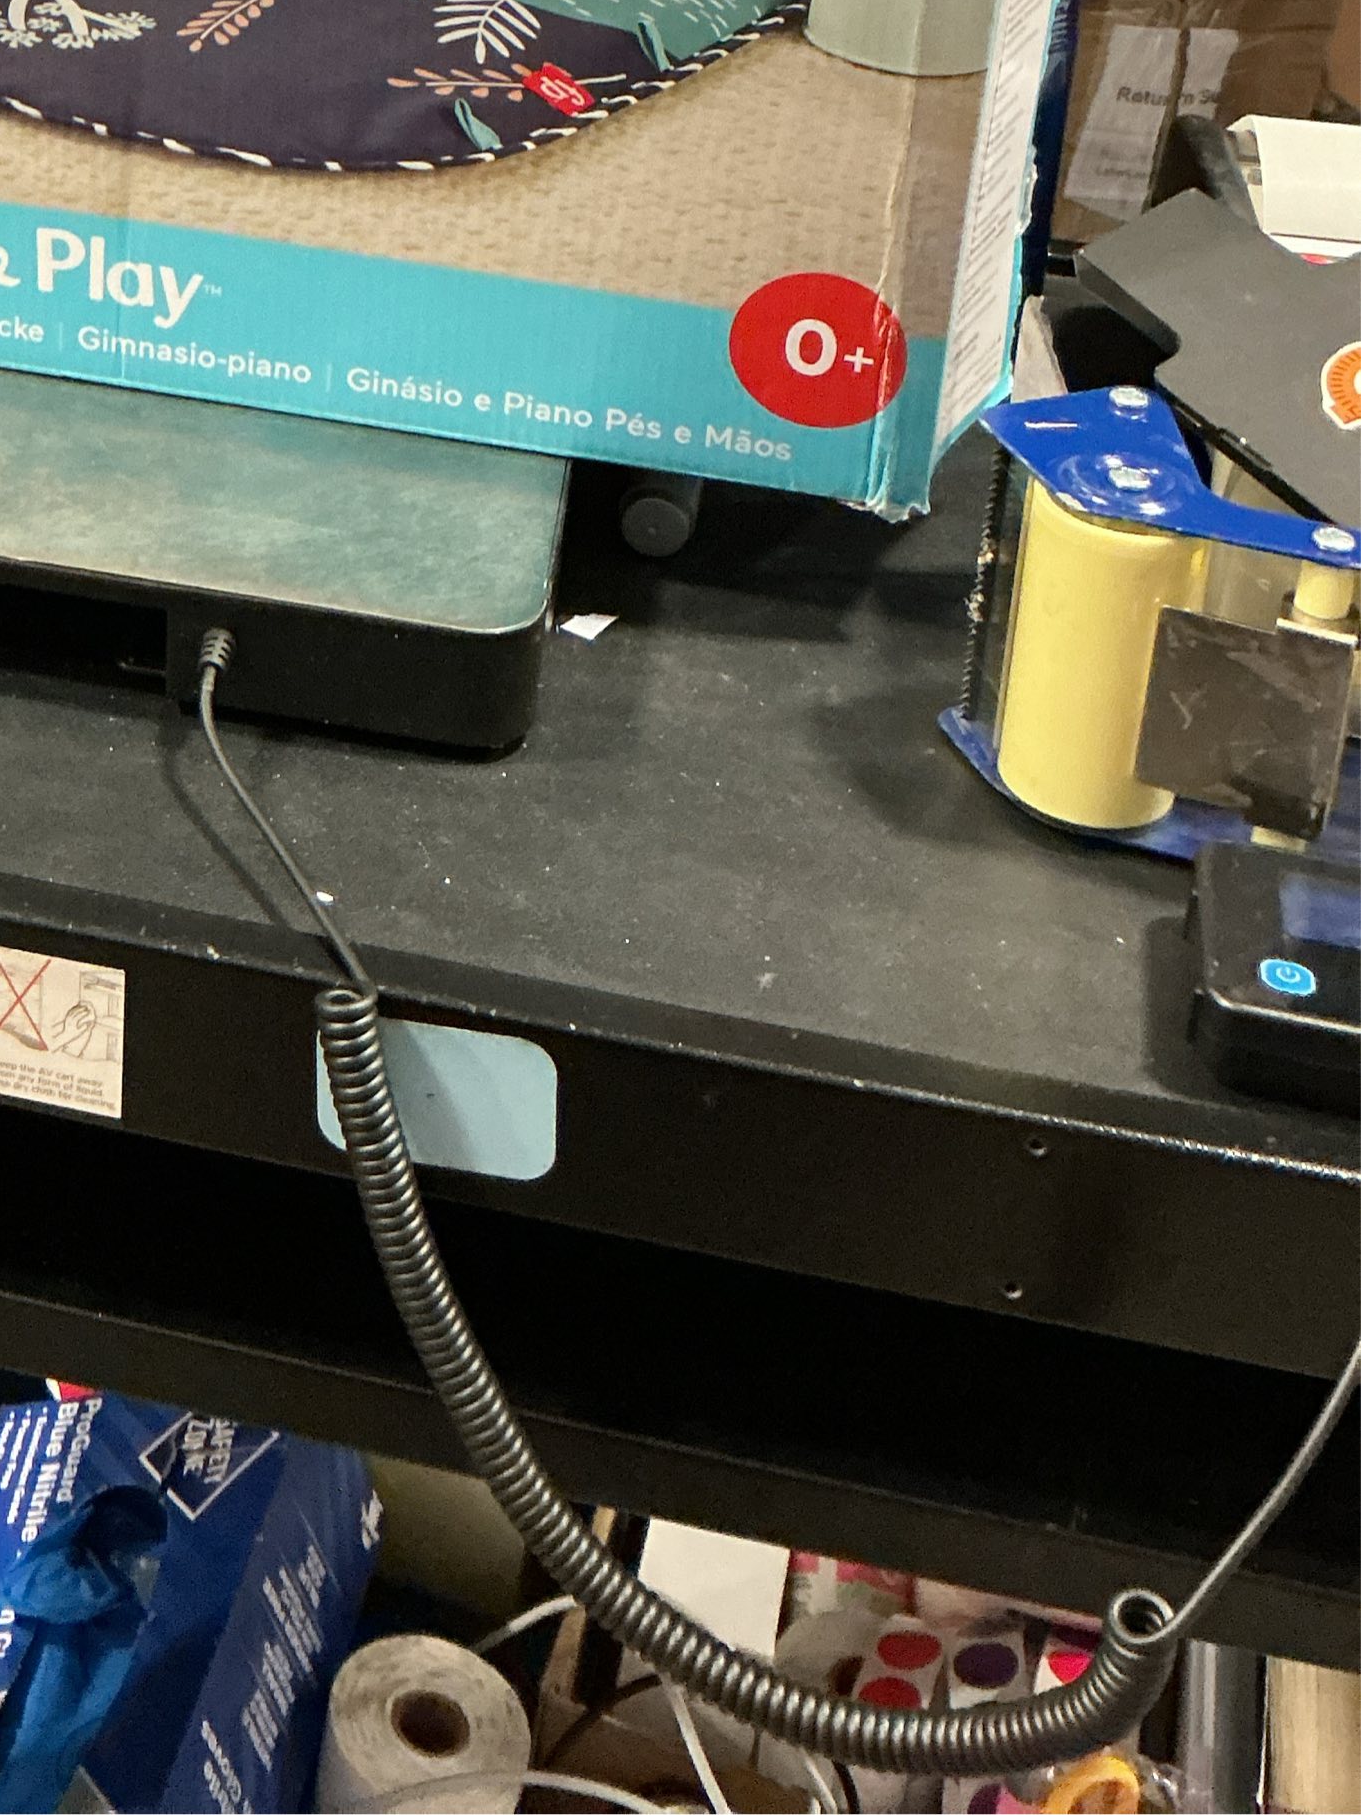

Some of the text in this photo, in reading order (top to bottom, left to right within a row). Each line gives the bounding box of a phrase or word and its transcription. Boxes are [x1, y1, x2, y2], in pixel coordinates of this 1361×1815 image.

[37, 228, 203, 330] Play
[77, 326, 312, 384] Gimnasio-piano
[346, 367, 463, 409] Ginásio
[474, 392, 491, 412] e
[504, 391, 593, 428] Piano
[606, 407, 661, 441] Pés
[674, 424, 692, 445] e
[705, 422, 793, 462] Mãos
[46, 1402, 80, 1457] Blue
[56, 1398, 103, 1503] ProGuard
[22, 1462, 60, 1543] Nitrile
